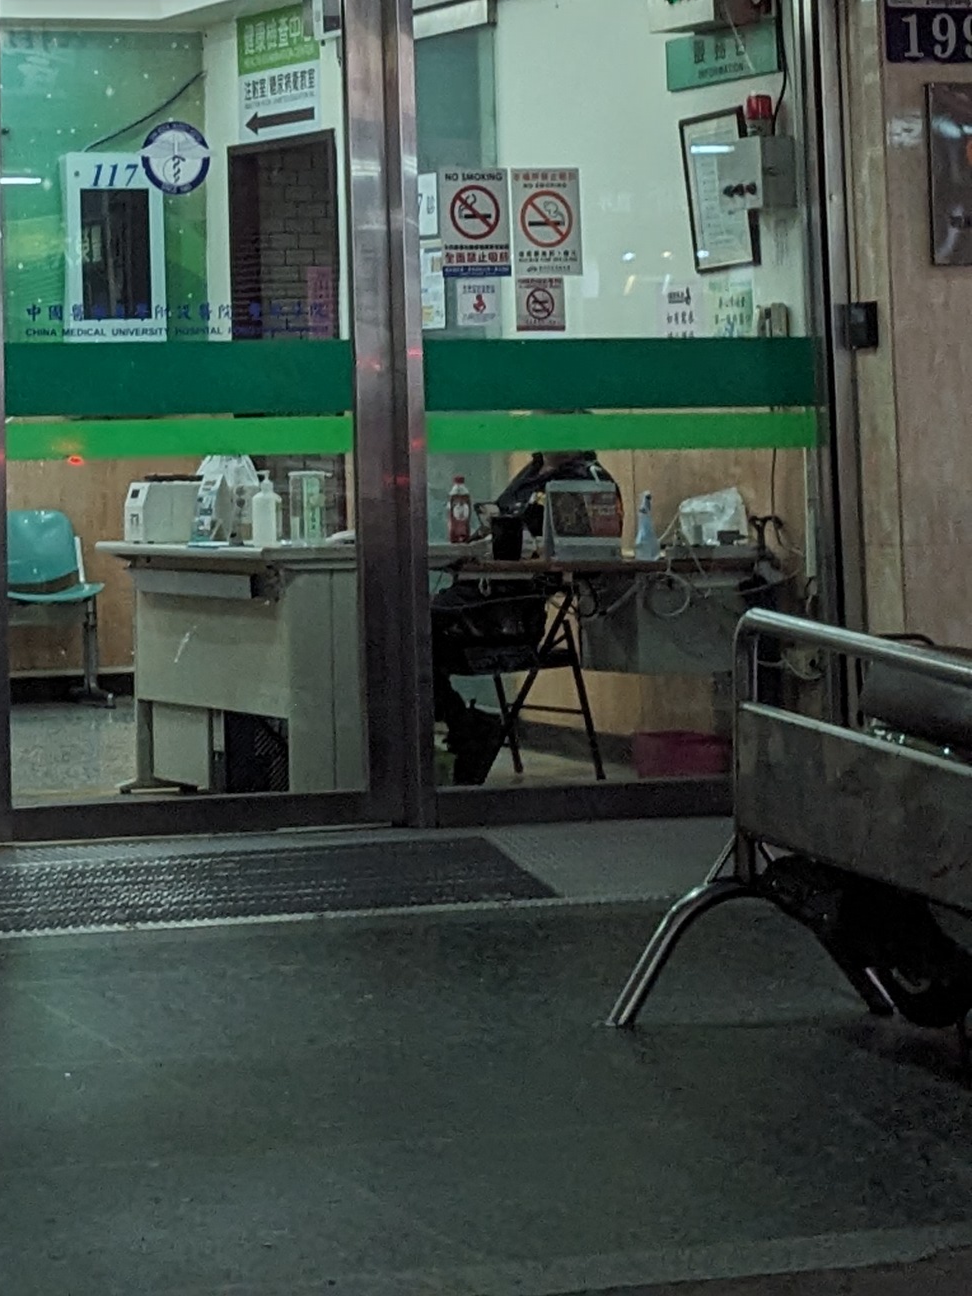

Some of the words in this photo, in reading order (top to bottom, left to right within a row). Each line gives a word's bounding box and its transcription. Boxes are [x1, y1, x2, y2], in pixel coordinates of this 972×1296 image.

[244, 15, 314, 55] 健康檢查中
[90, 163, 139, 188] 117
[445, 172, 459, 181] NO
[462, 172, 503, 181] SMOKING
[25, 328, 57, 337] CHINA
[63, 328, 106, 337] MEDICAL
[112, 328, 170, 337] UNIVERSITY
